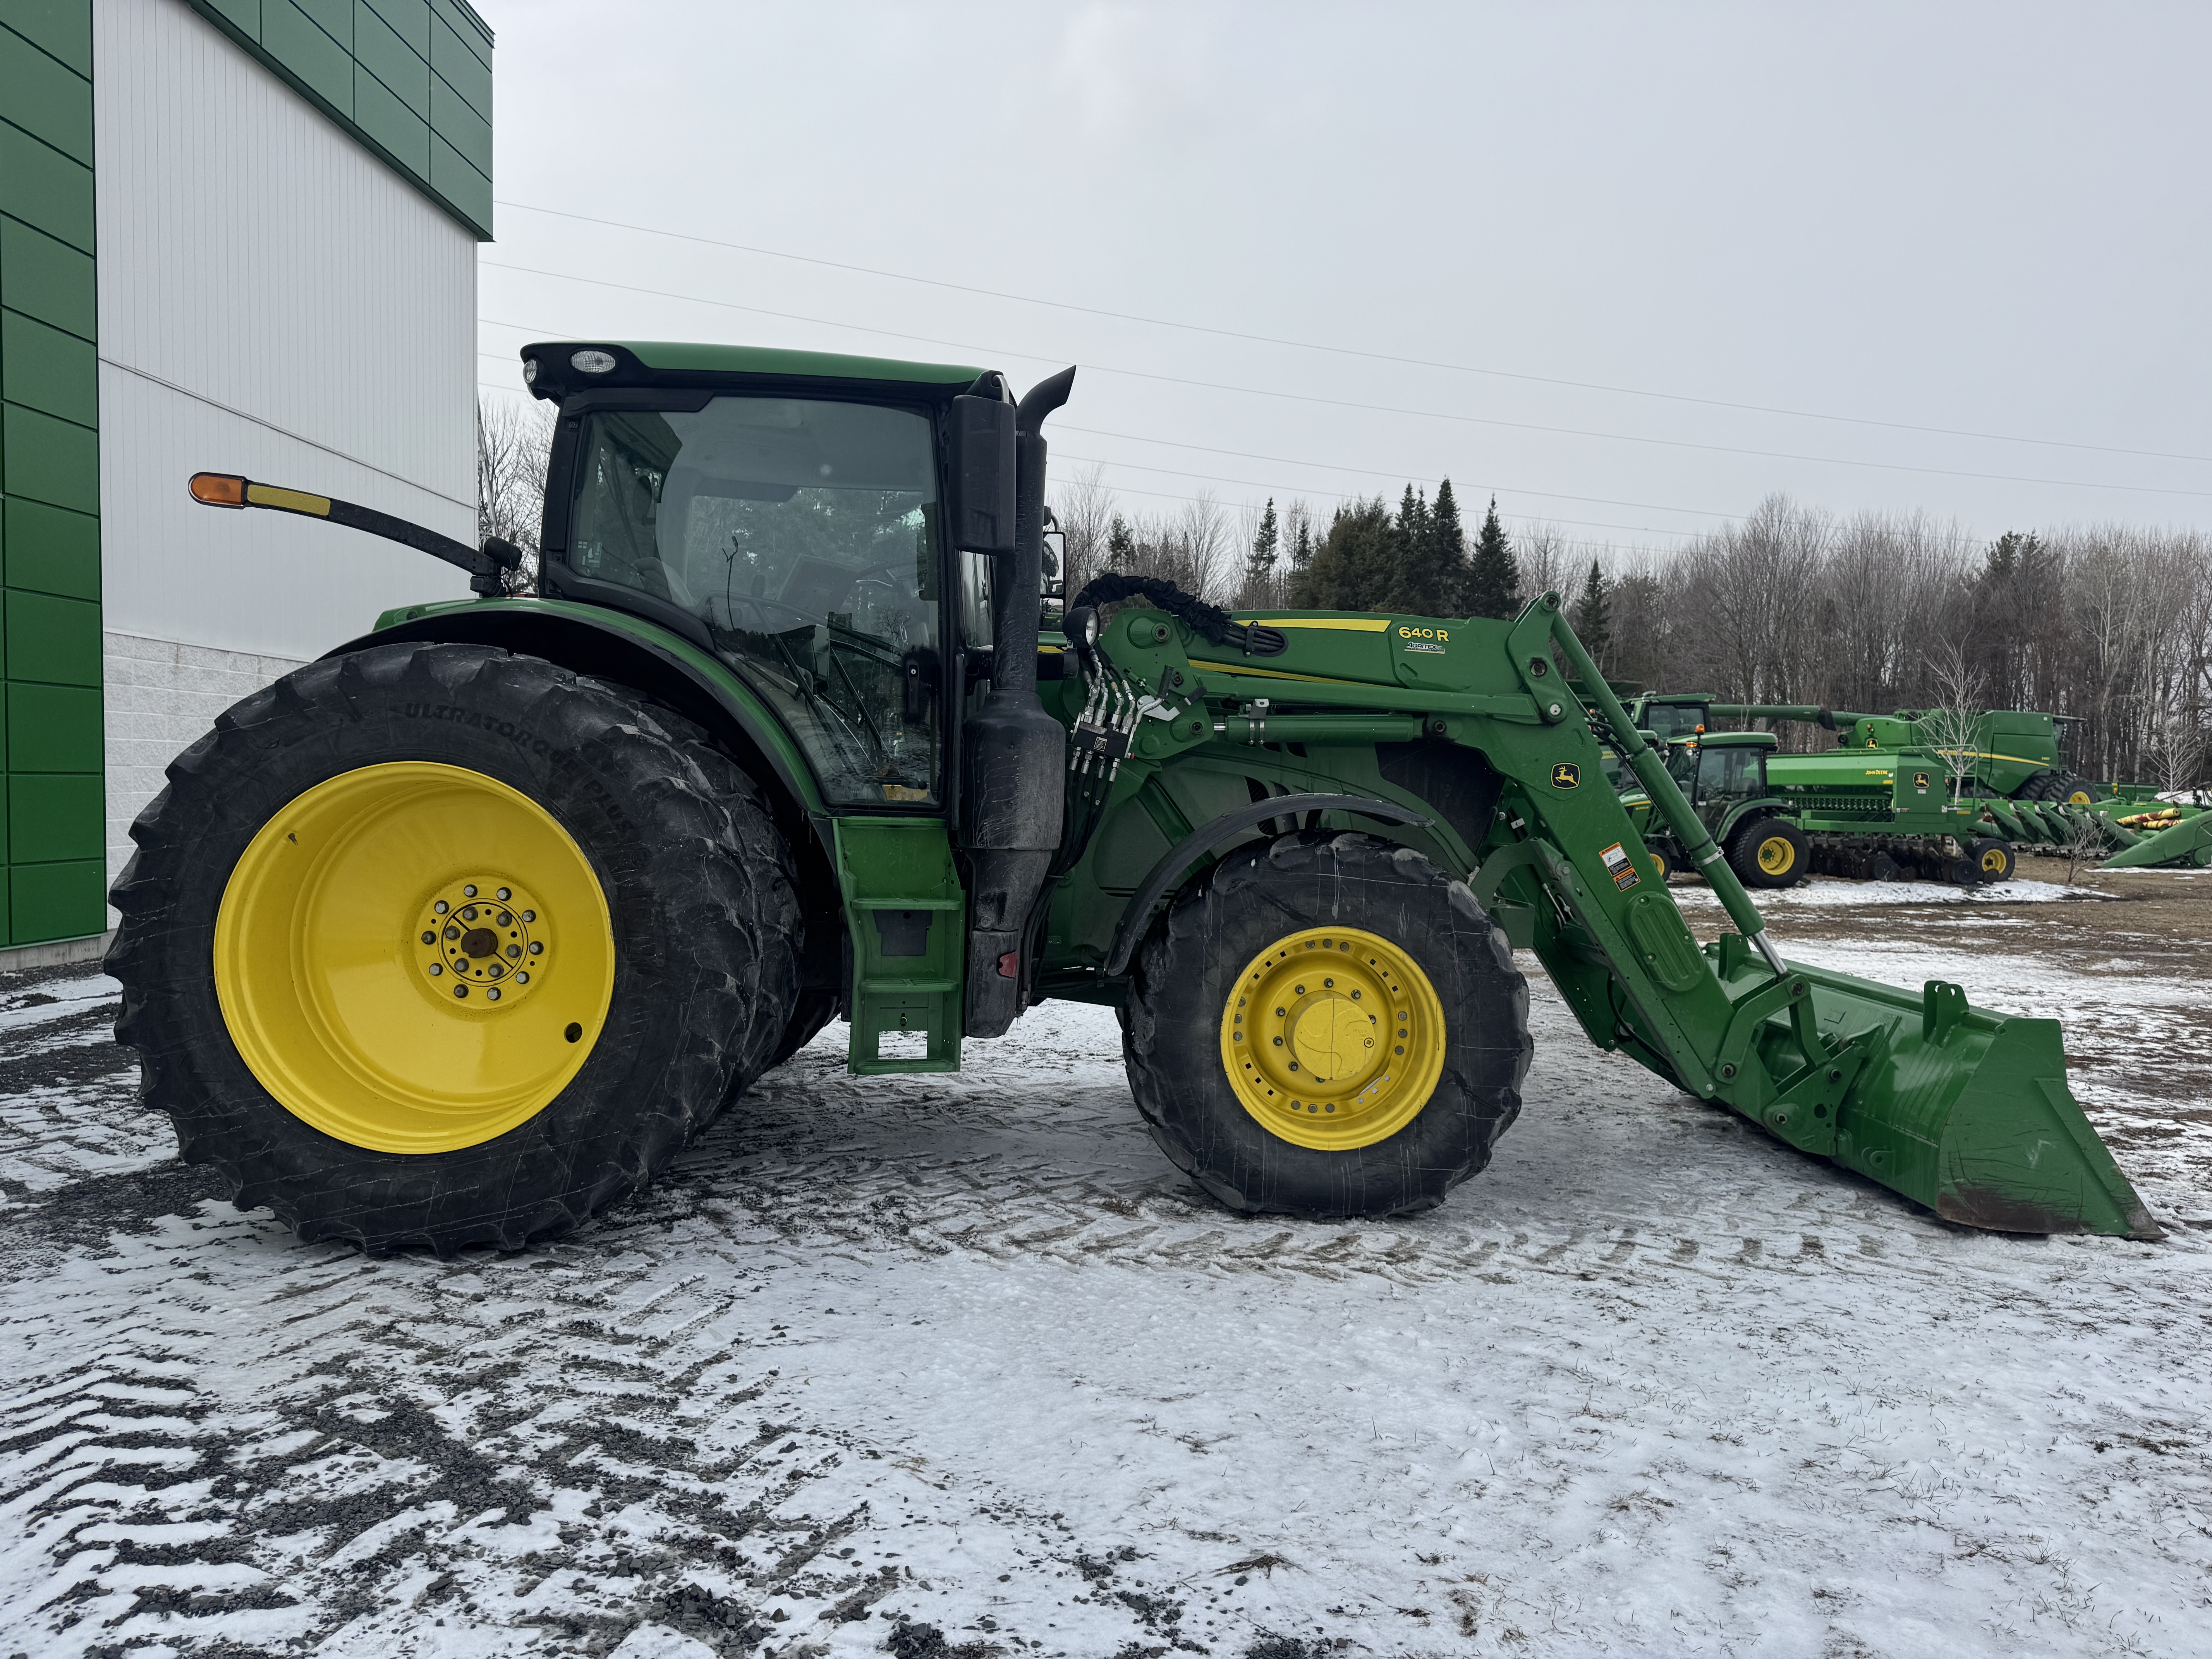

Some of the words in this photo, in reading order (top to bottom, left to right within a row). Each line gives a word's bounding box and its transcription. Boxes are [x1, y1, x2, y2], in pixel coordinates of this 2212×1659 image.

[1398, 627, 1433, 638] 640
[1436, 629, 1449, 642] R
[406, 702, 580, 773] ULTRATORQUE
[583, 779, 634, 835] PLUS
